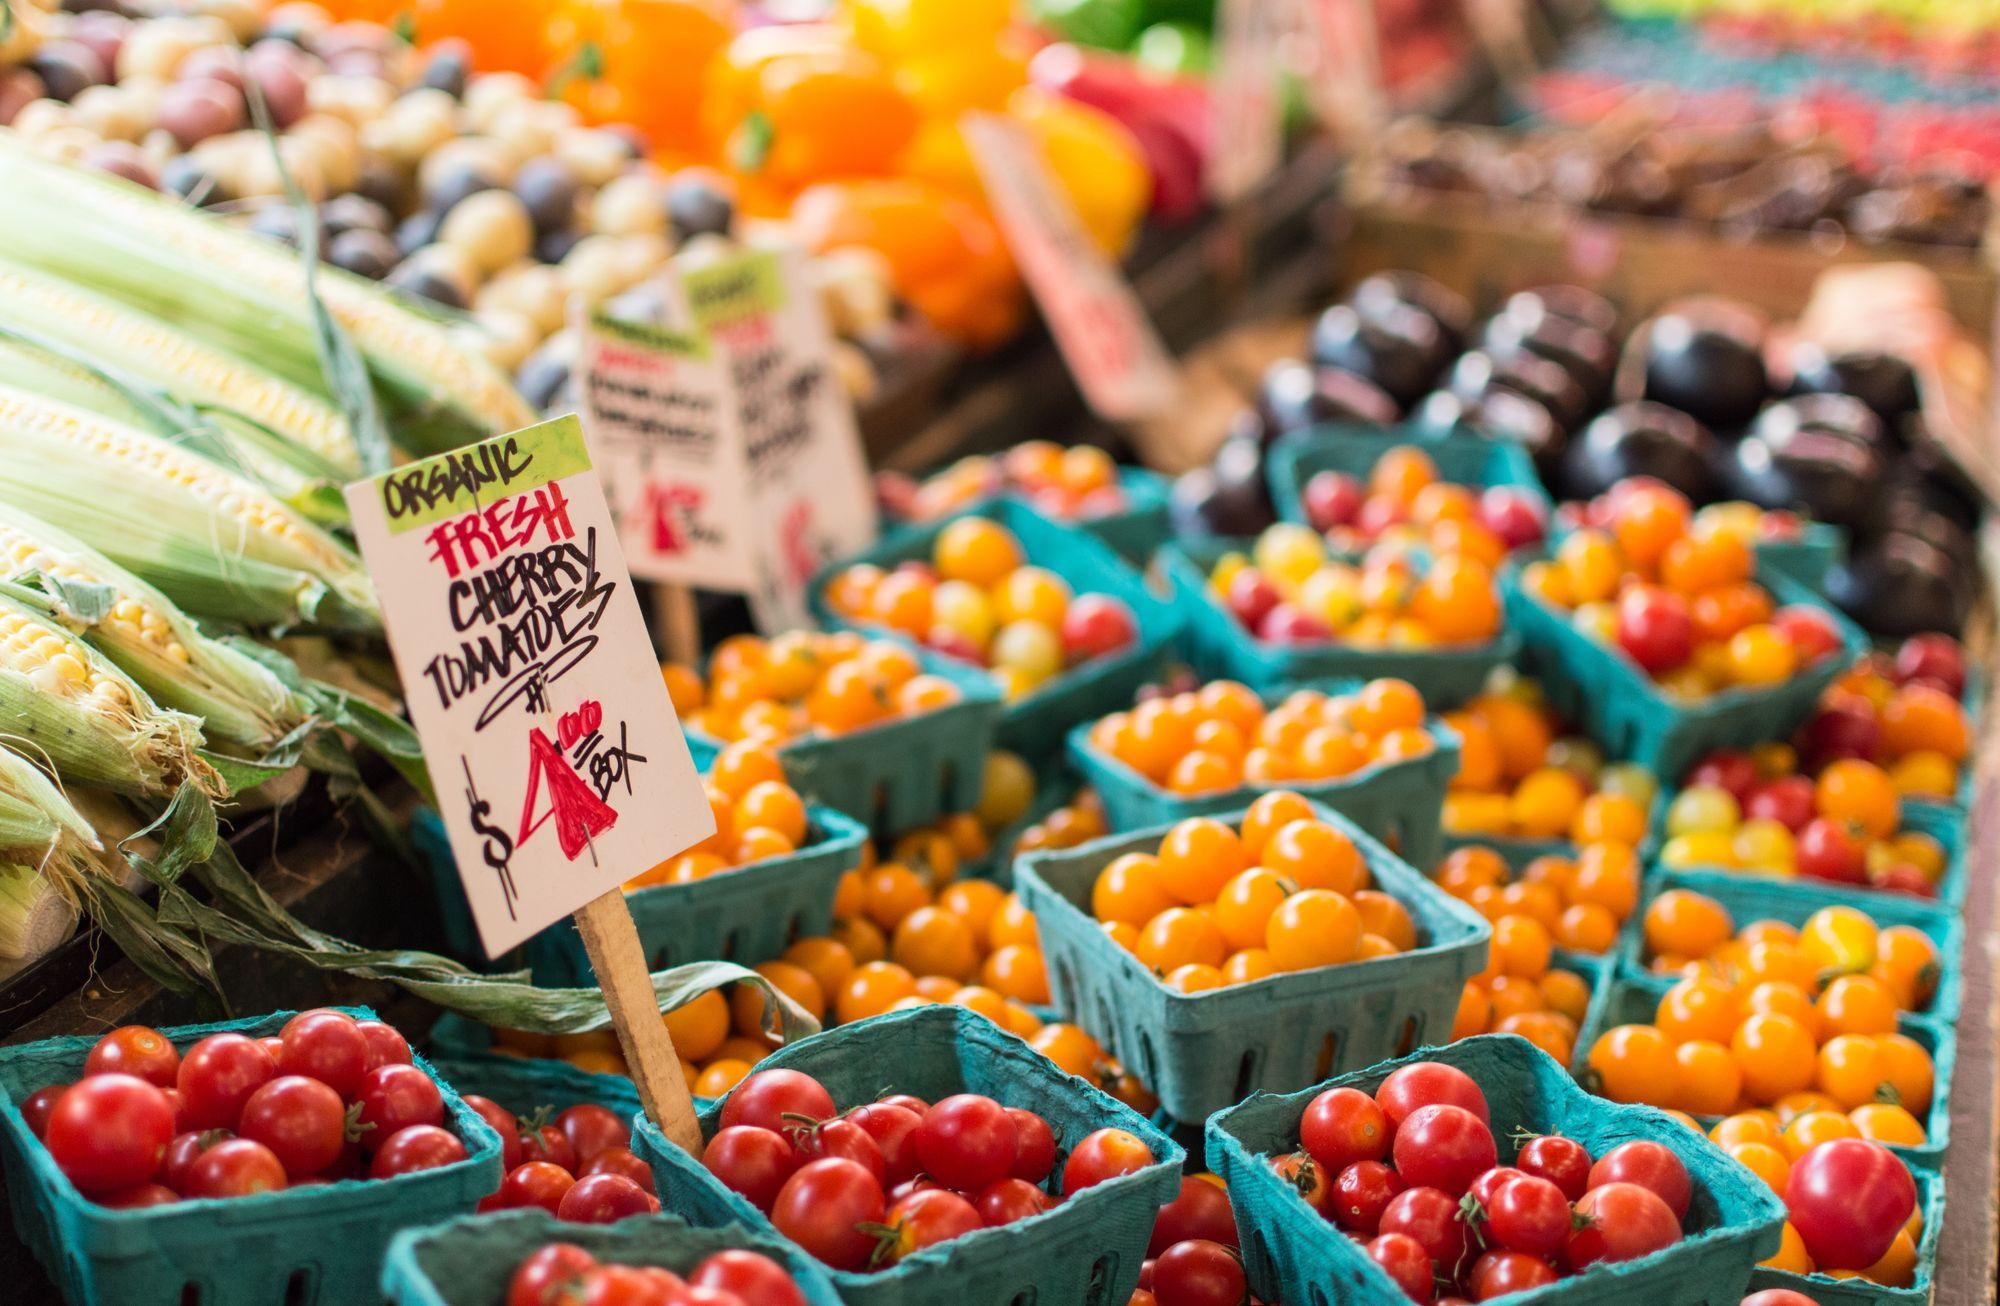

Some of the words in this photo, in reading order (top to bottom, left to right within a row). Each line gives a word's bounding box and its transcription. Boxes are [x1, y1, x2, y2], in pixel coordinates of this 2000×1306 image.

[384, 438, 533, 519] ORGANIC
[425, 480, 575, 578] FRESH
[449, 527, 597, 632] CHERRY
[424, 572, 616, 710] TOMATOES
[590, 720, 648, 804] BOX
